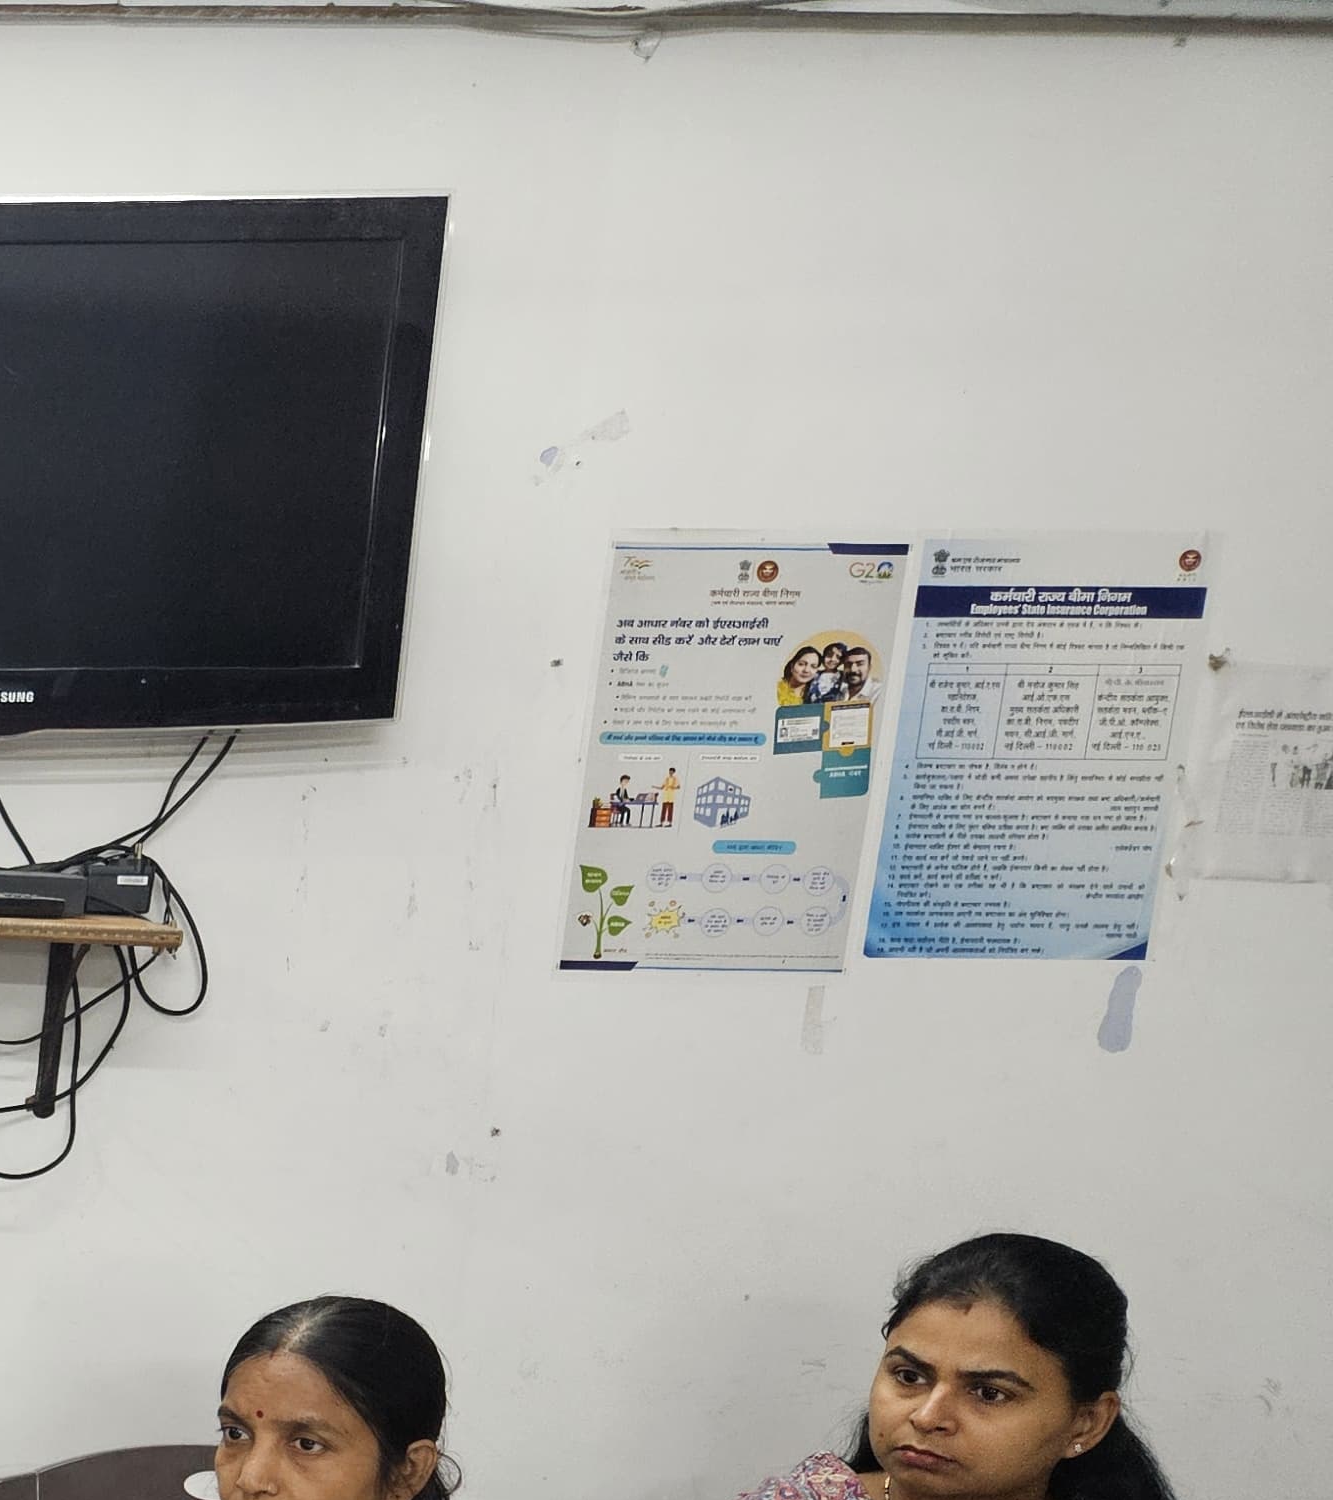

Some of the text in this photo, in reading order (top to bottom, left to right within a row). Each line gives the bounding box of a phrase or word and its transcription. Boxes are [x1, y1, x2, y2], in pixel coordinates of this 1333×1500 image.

[1022, 604, 1046, 615] State
[1046, 604, 1092, 615] Insurance
[1093, 604, 1148, 616] Corporation
[616, 619, 634, 629] अब
[636, 619, 668, 629] आधार
[695, 618, 709, 629] को
[697, 634, 716, 646] और
[635, 650, 650, 662] कि
